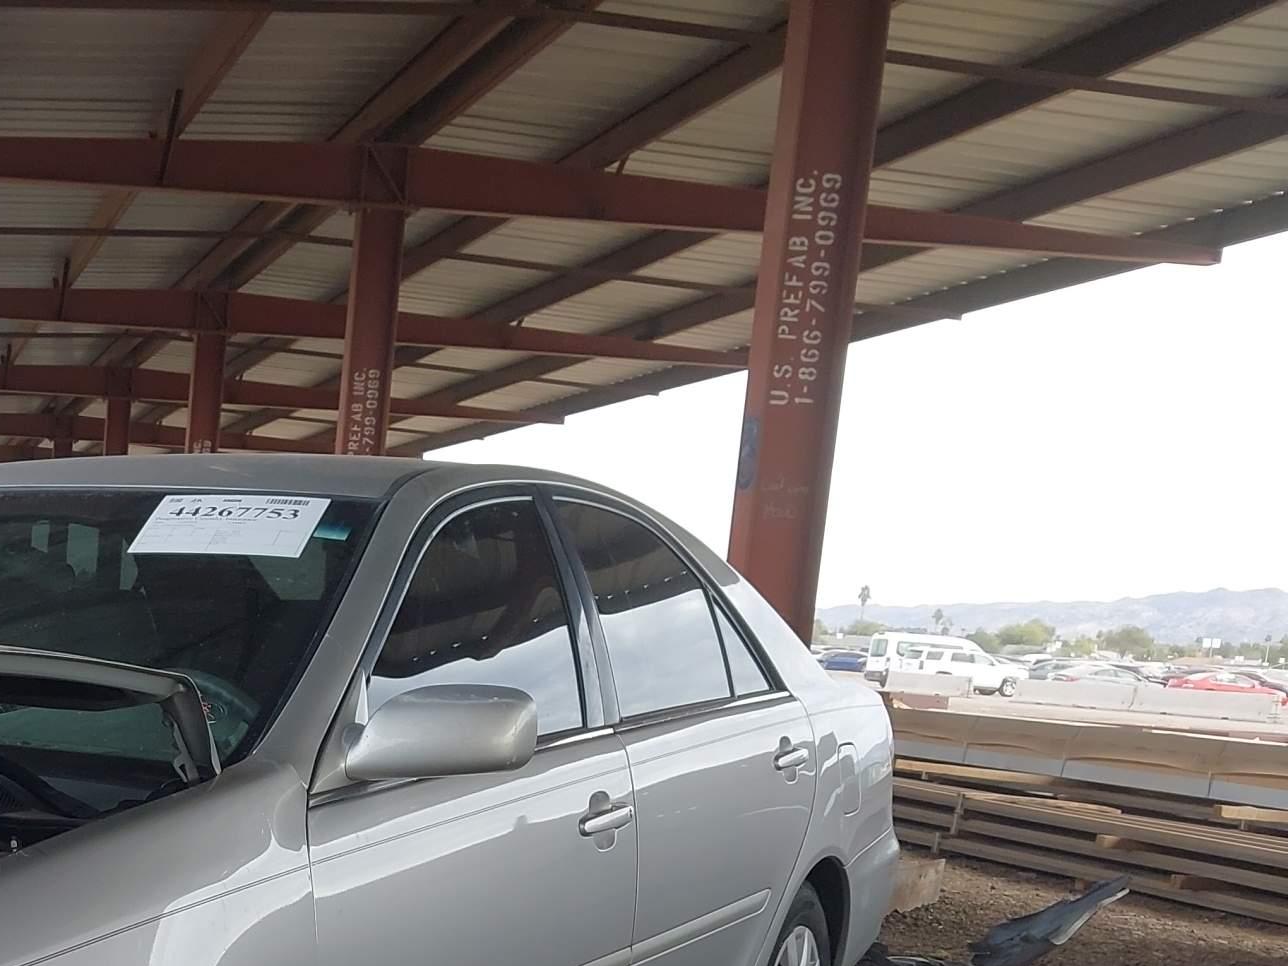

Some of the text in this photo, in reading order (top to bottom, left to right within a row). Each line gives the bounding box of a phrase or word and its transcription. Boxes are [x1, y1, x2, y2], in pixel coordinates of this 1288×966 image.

[769, 169, 818, 406] U.S. PREFAB INC.
[794, 172, 842, 404] 1-866-799-0969
[352, 367, 366, 396] INC.
[361, 369, 380, 455] -799-0969
[168, 505, 301, 520] 44267753
